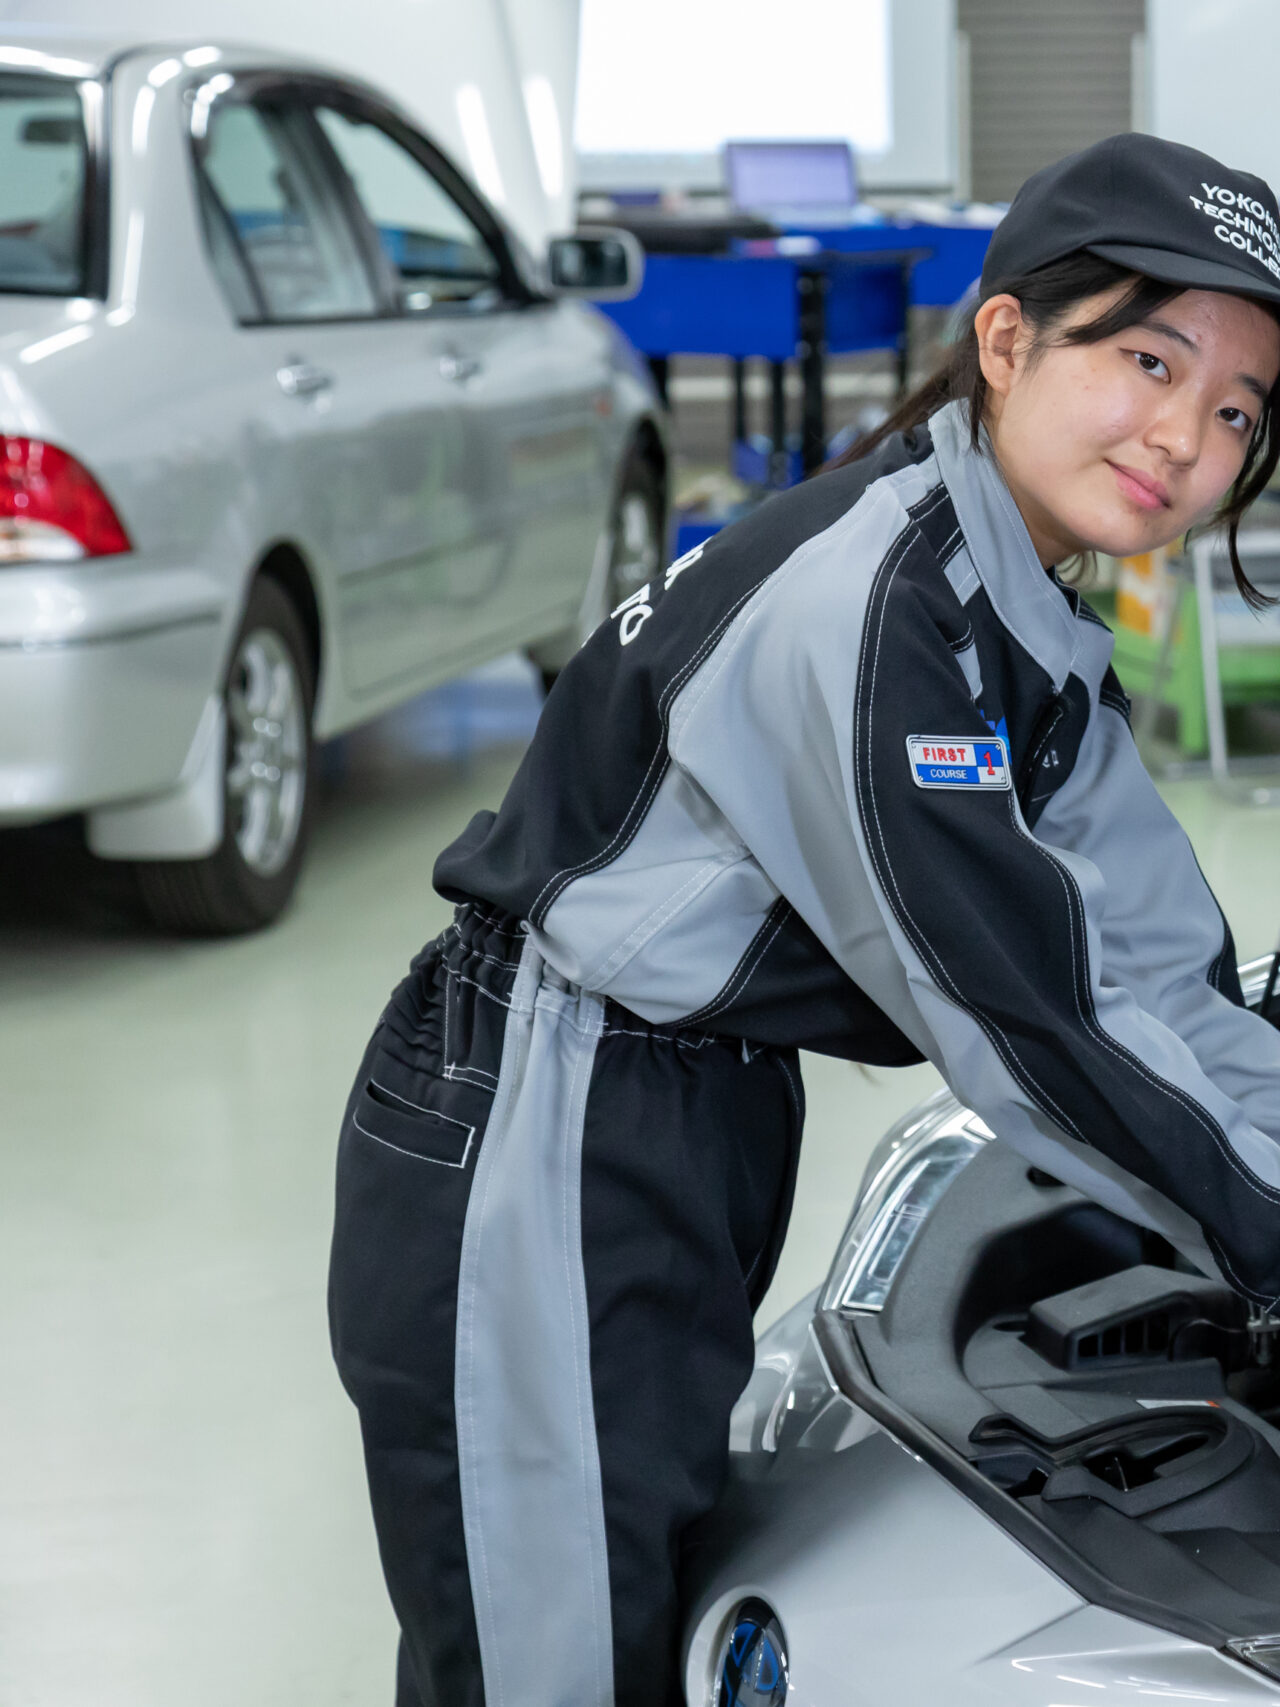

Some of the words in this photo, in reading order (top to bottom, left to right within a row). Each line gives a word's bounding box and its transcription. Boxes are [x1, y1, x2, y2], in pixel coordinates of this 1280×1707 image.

[923, 747, 966, 762] FIRST
[983, 751, 996, 775] 1
[930, 769, 968, 779] COURSE
